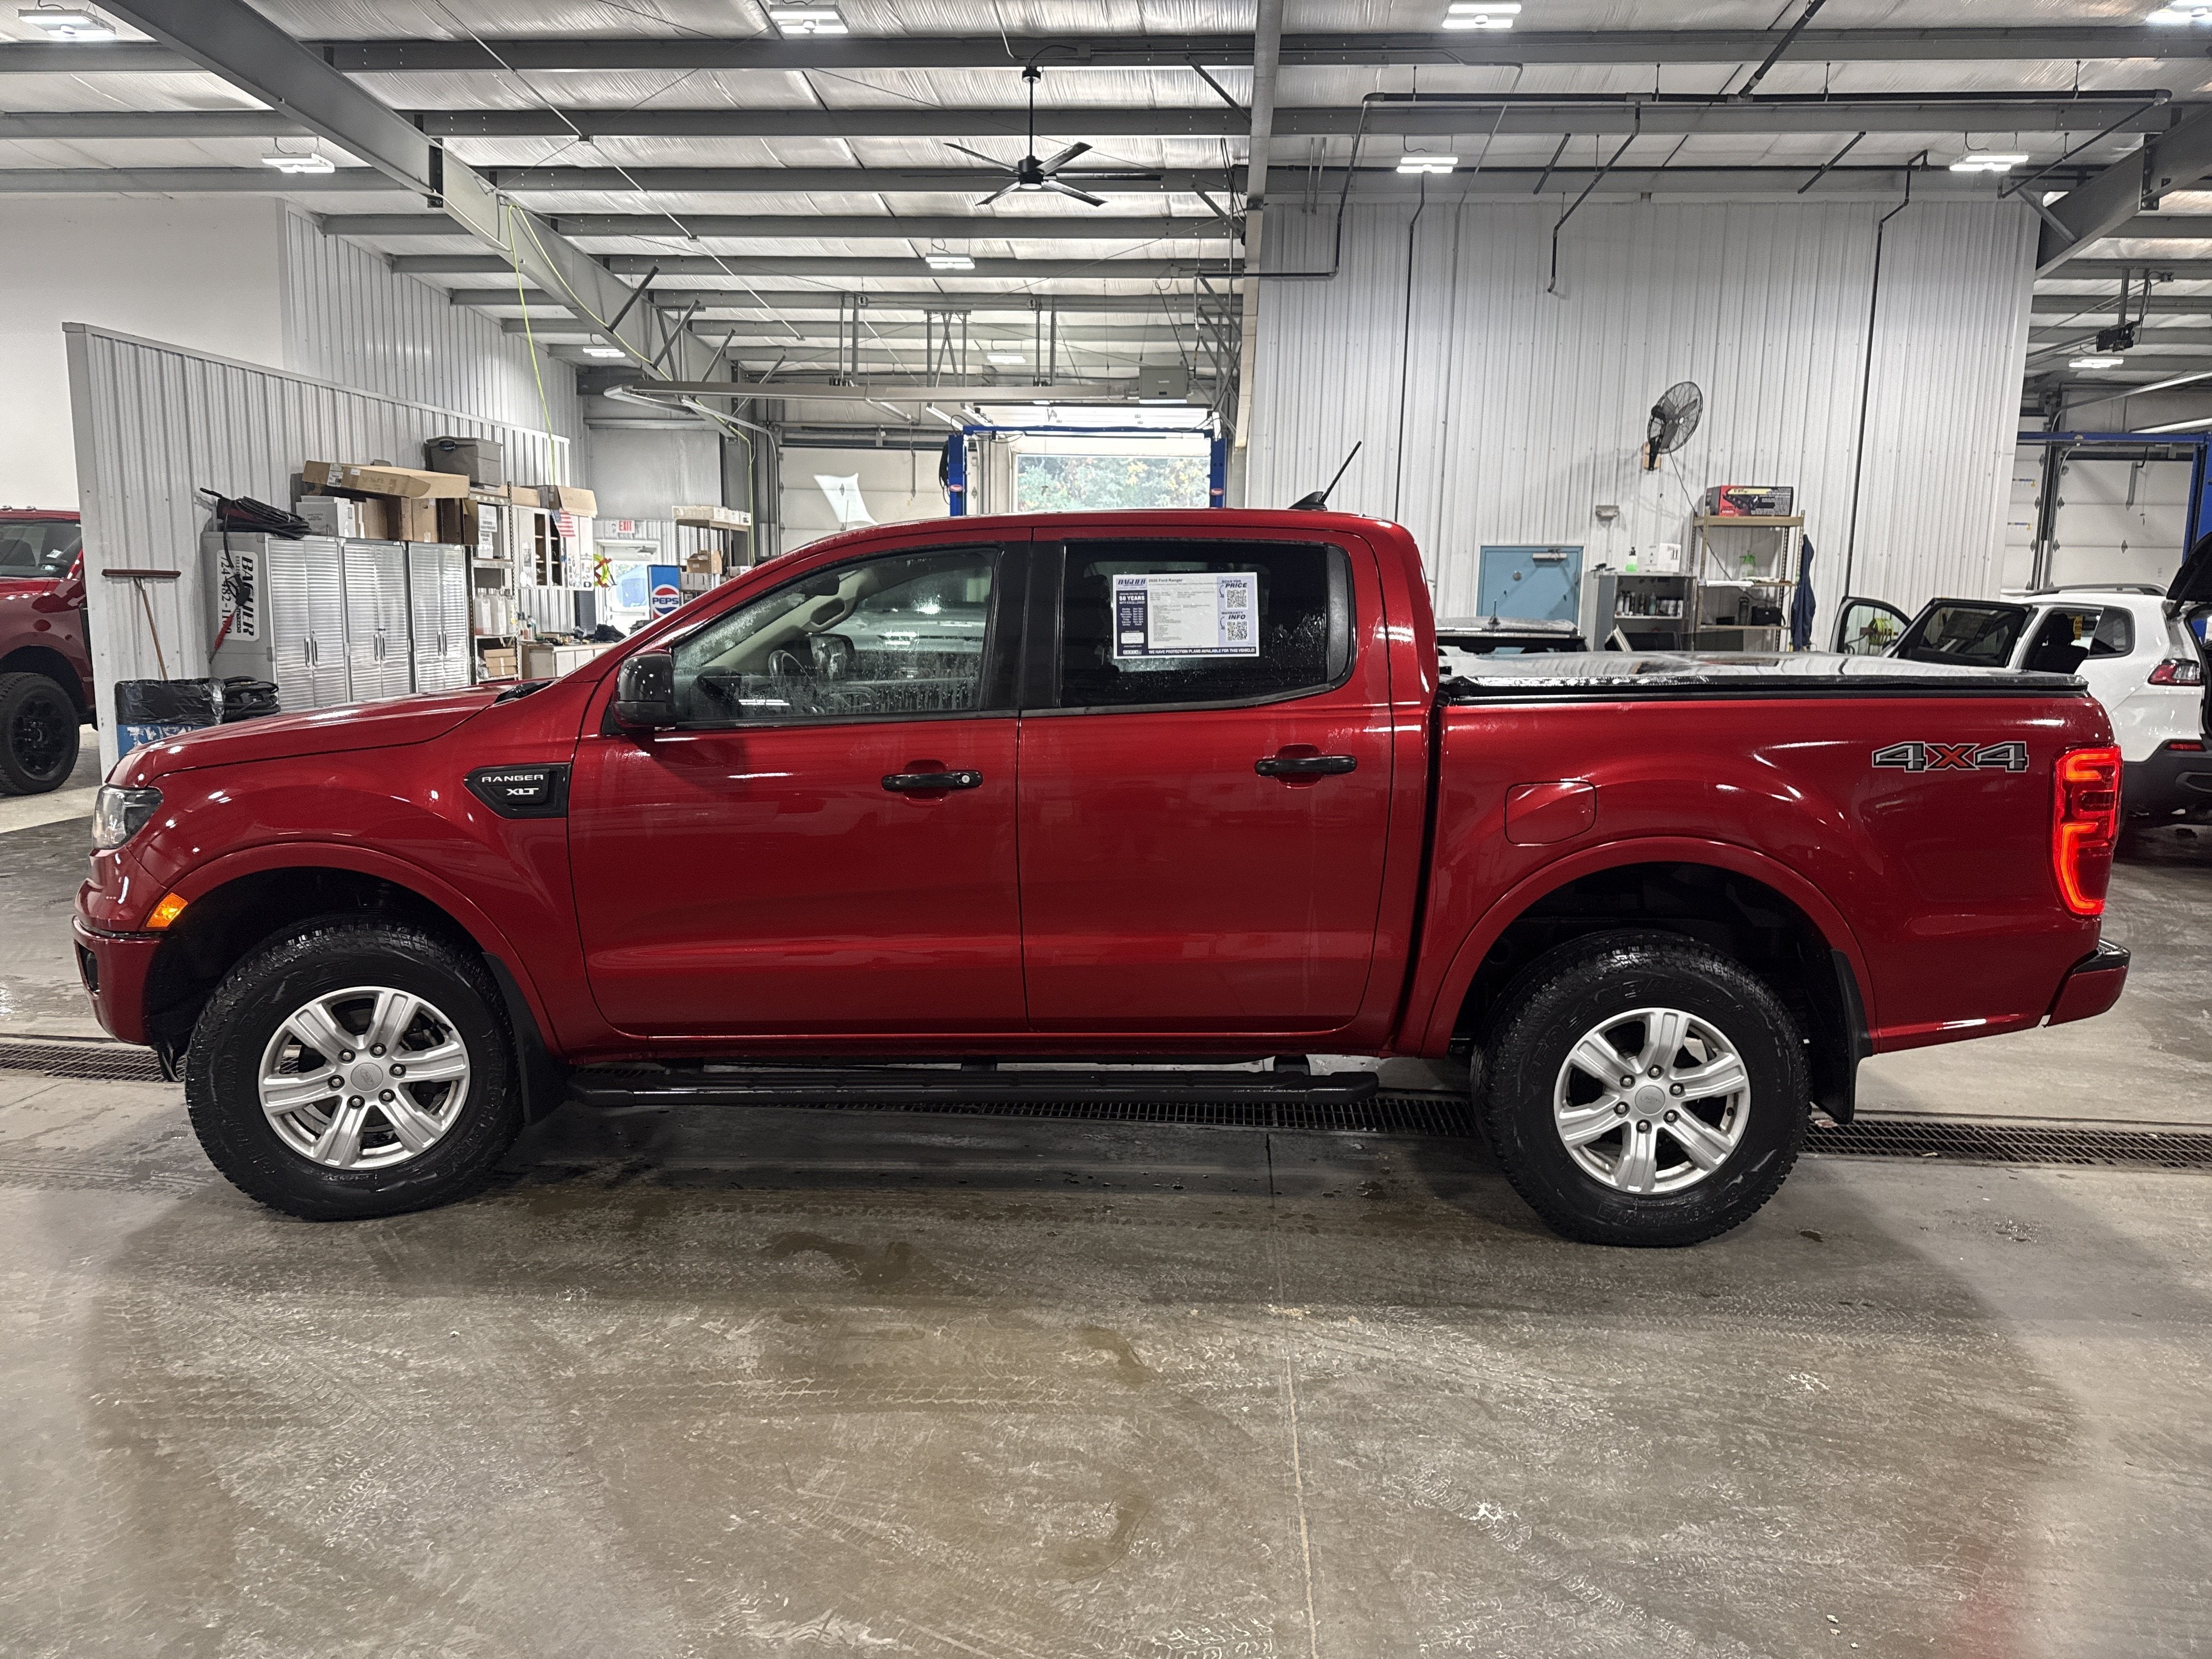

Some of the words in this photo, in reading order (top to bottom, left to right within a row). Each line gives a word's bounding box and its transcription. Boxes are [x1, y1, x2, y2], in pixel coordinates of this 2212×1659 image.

[619, 521, 632, 531] EXIT
[481, 774, 544, 783] RANGER
[506, 787, 539, 795] XLT
